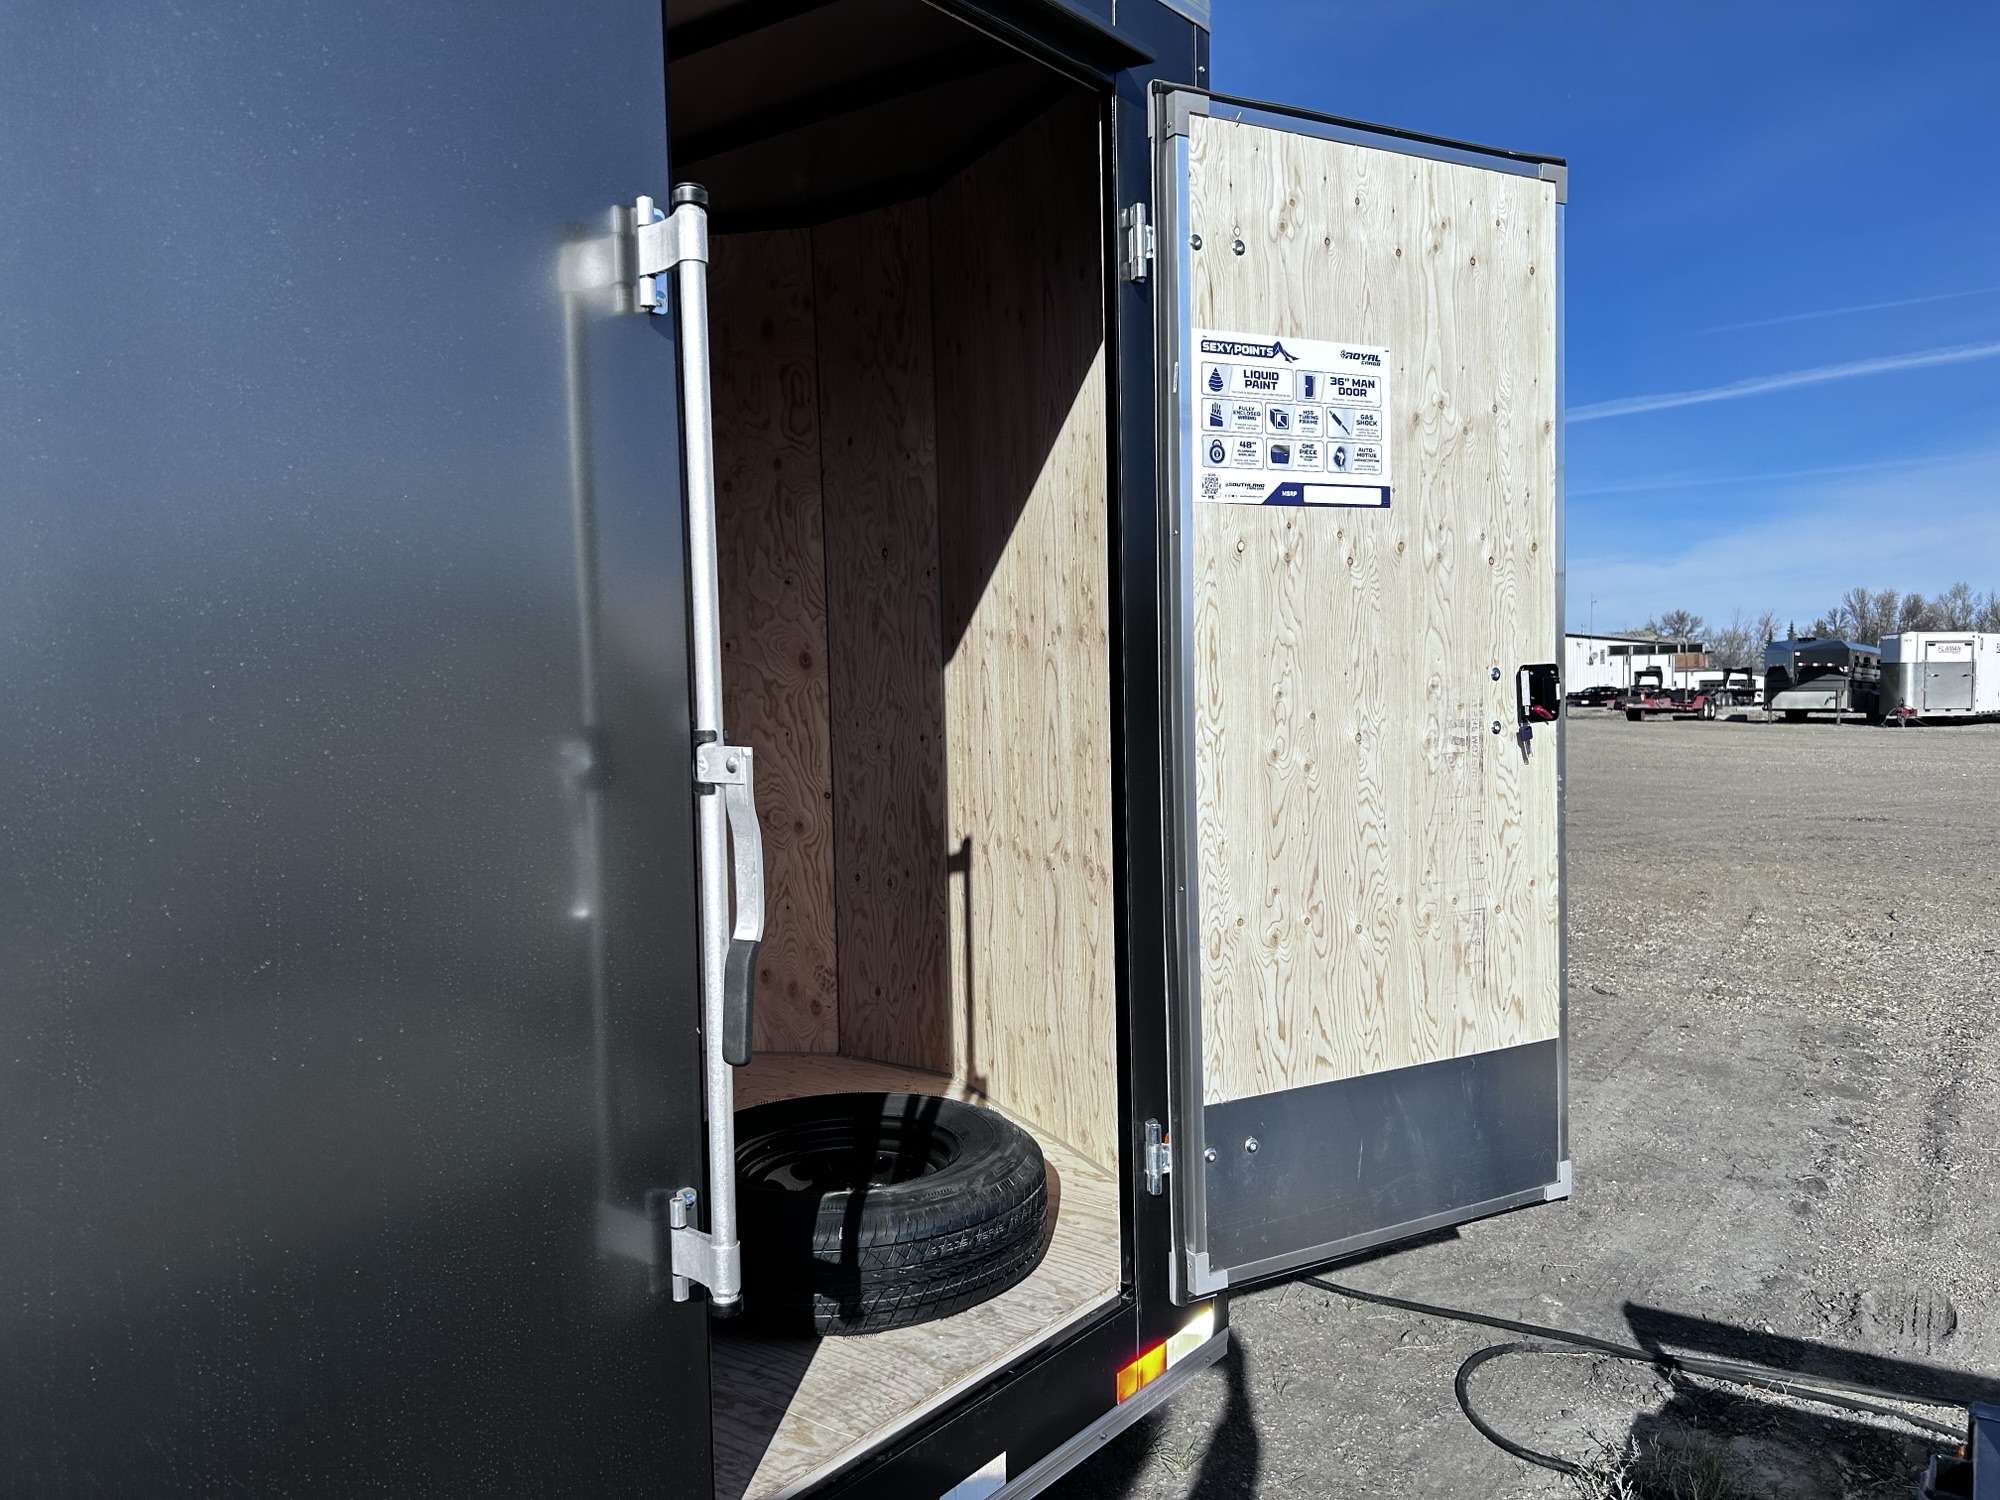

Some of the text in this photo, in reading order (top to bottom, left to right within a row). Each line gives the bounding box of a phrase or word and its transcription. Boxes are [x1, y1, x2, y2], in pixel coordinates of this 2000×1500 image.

[1202, 341, 1274, 357] SEXY POINTS
[1345, 351, 1381, 362] ROYAL
[1243, 369, 1279, 381] LIQUID
[1244, 380, 1278, 391] PAINT
[1352, 378, 1375, 389] MAN
[1338, 387, 1367, 398] DOOR
